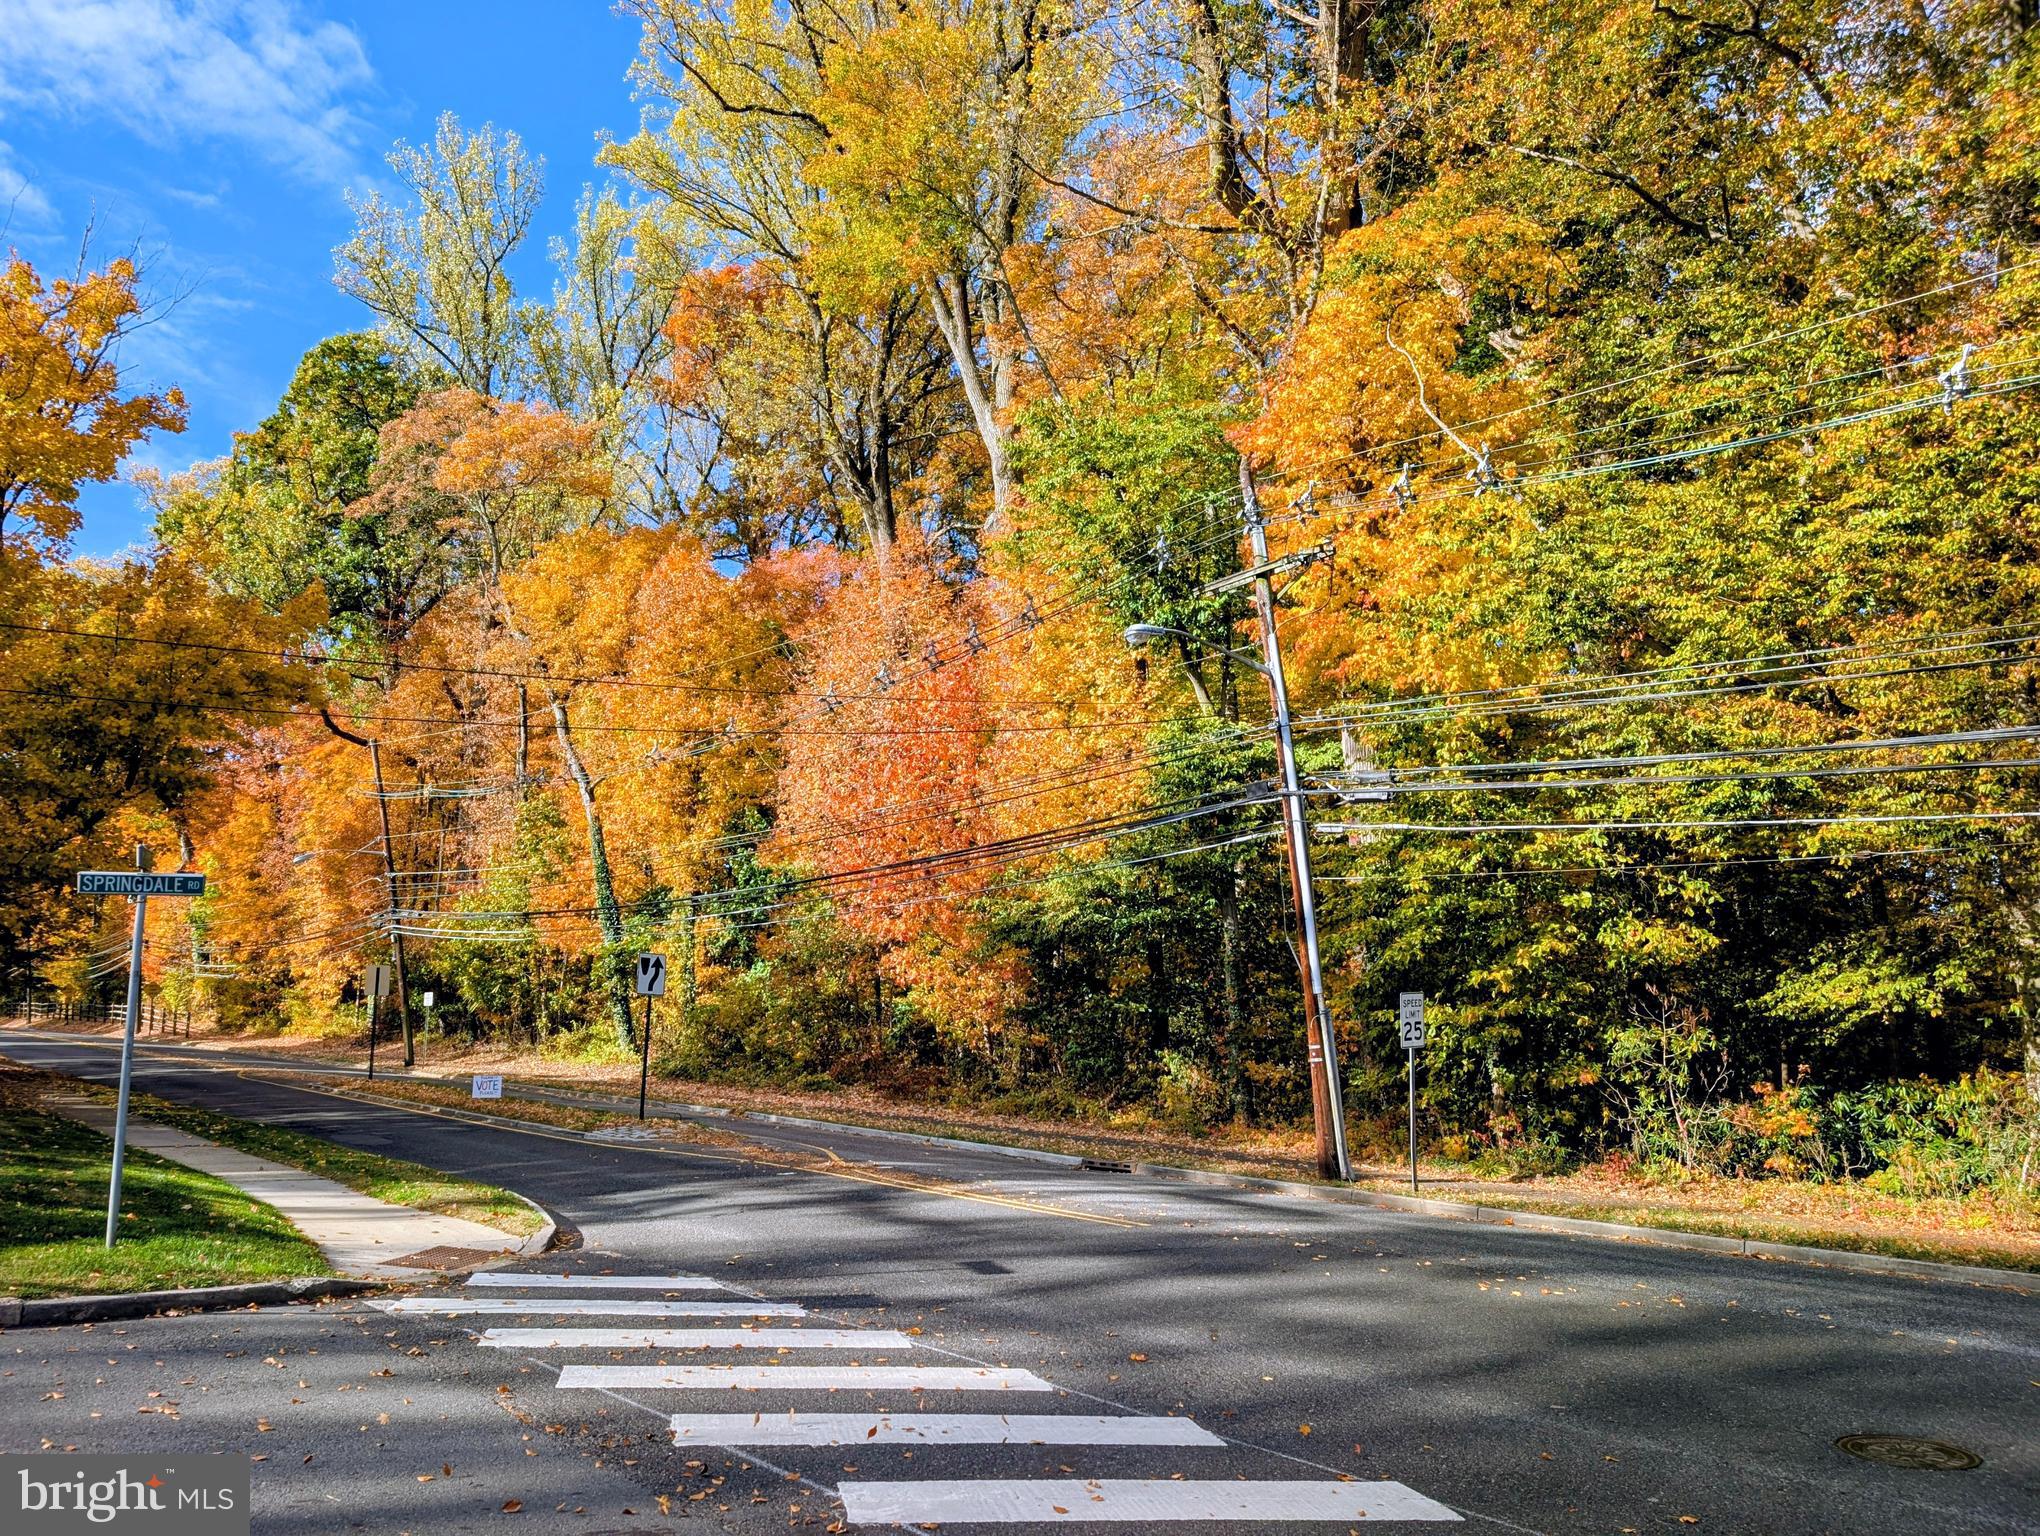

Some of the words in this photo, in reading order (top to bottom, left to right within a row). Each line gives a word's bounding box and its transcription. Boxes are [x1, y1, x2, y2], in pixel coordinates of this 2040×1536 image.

[82, 875, 184, 893] SPRINGDALE
[187, 880, 200, 890] RD
[1402, 999, 1422, 1008] SPEED
[1405, 1010, 1420, 1019] LIMIT
[1403, 1021, 1423, 1041] 25
[476, 1080, 499, 1091] VOTE
